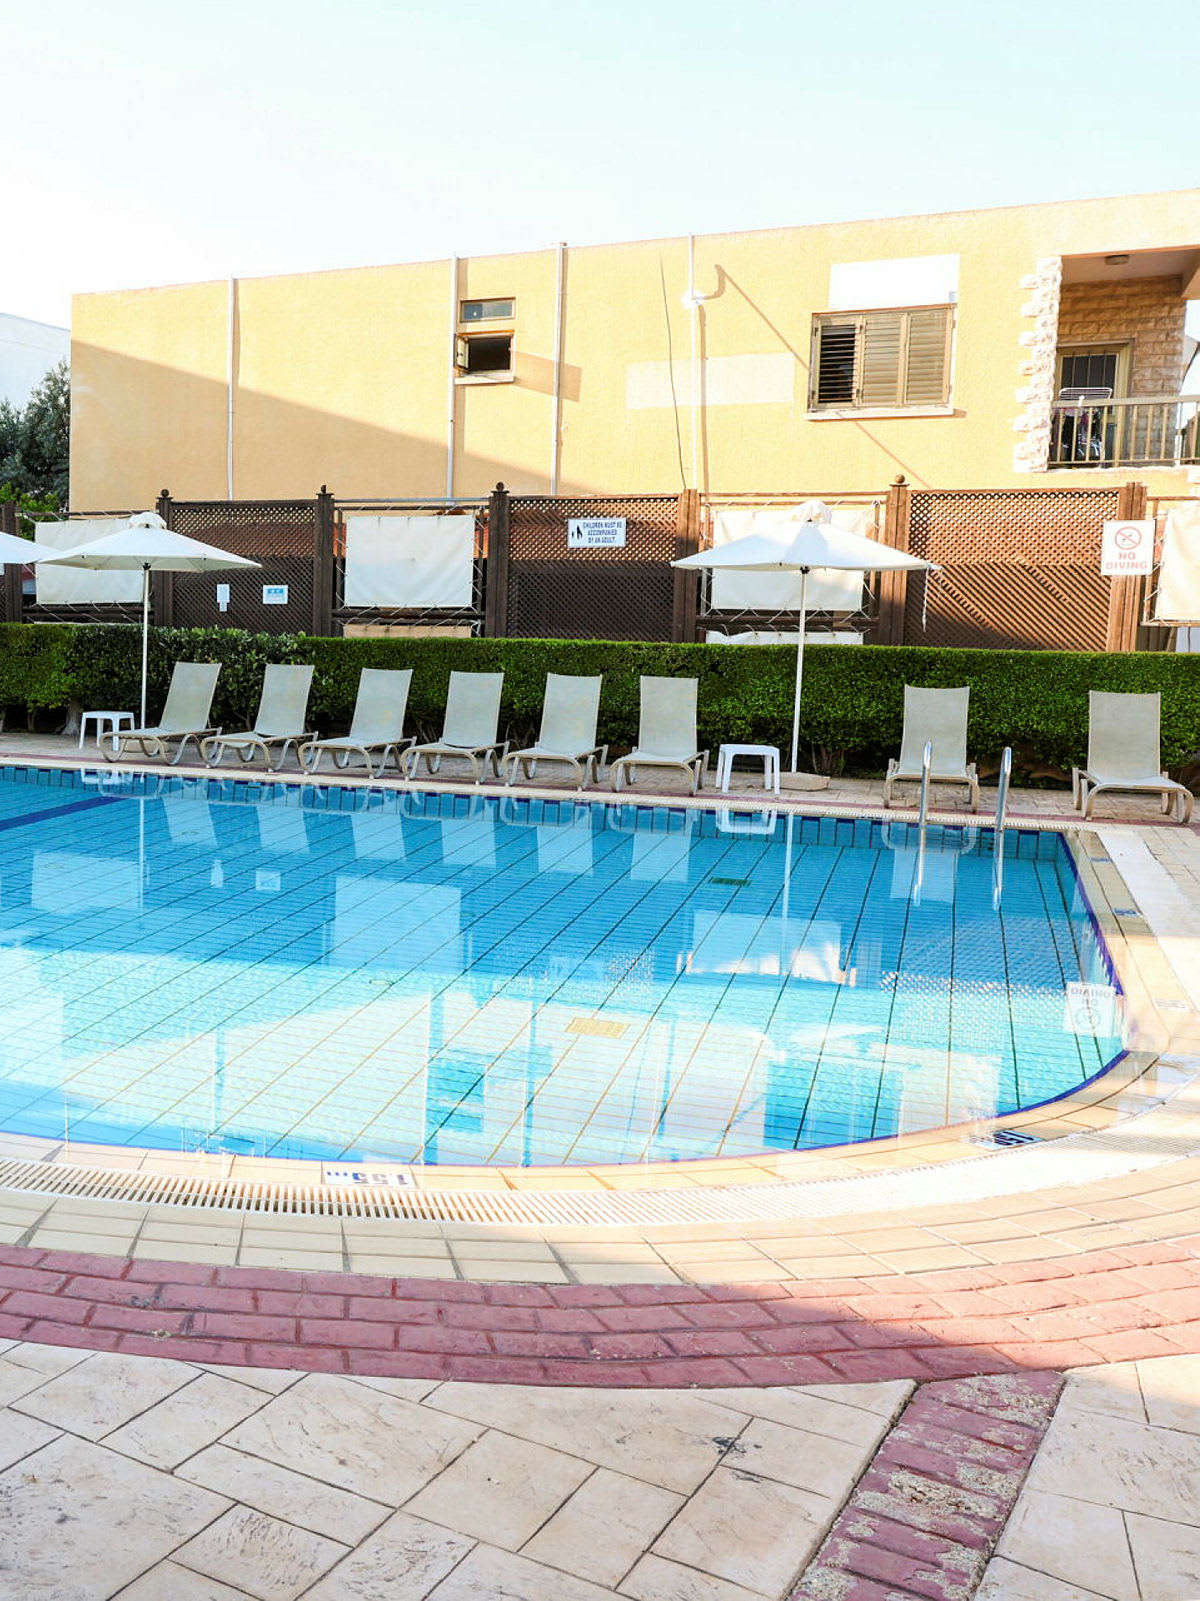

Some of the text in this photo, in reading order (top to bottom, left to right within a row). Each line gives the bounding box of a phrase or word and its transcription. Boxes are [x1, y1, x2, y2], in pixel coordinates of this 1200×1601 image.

[582, 521, 603, 529] CHILDREN
[1118, 552, 1136, 560] NO
[1105, 561, 1148, 570] DIVING
